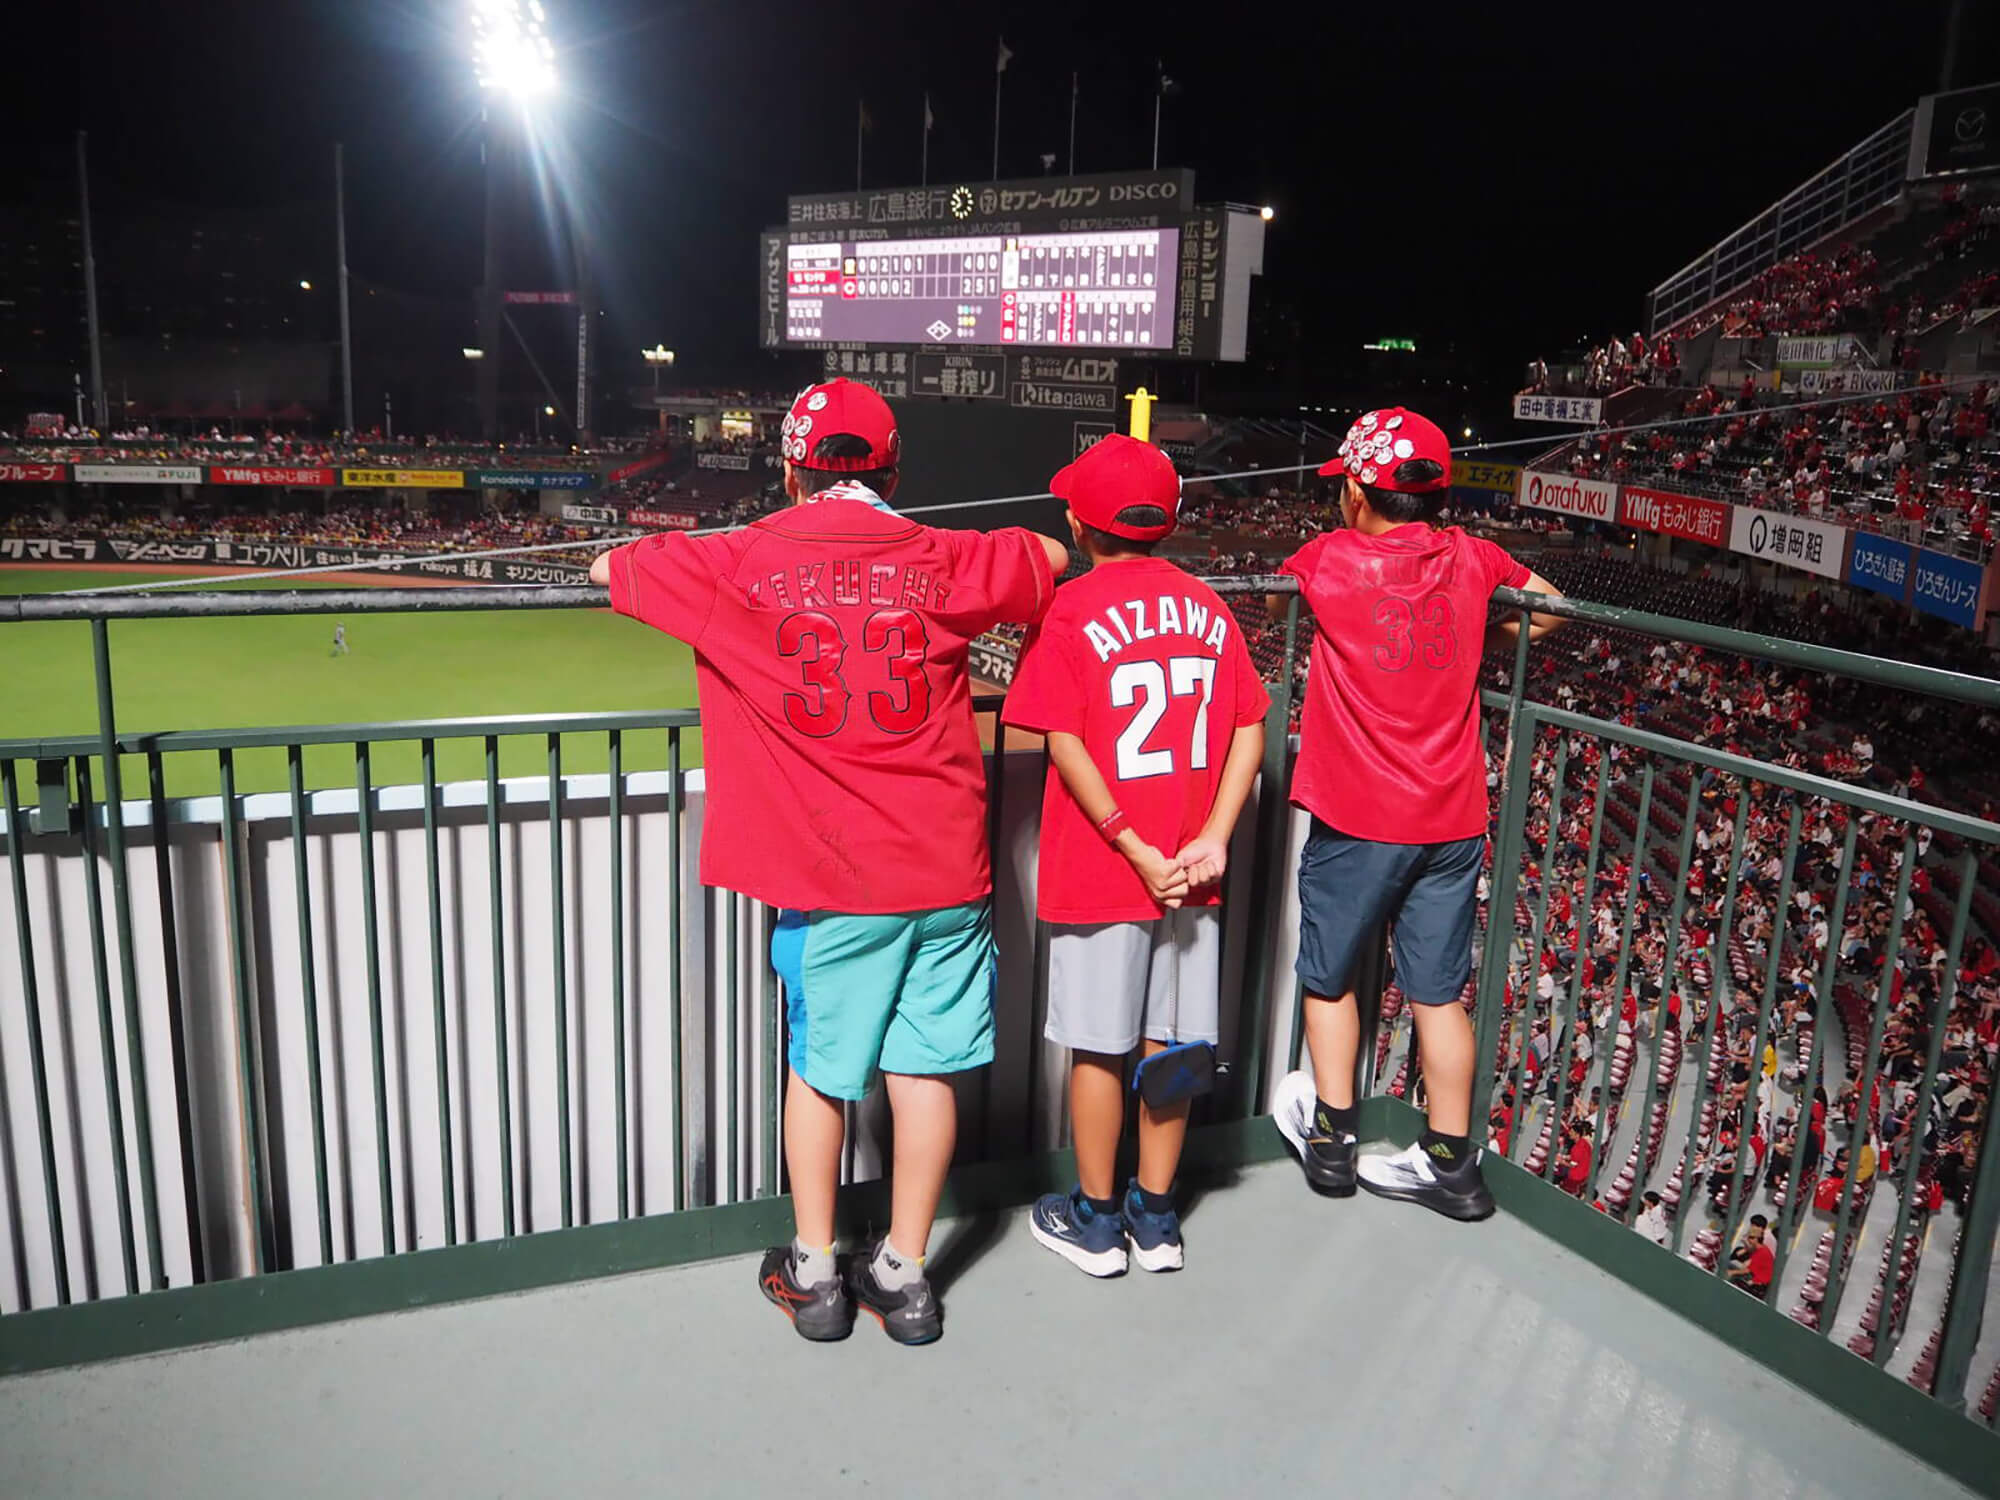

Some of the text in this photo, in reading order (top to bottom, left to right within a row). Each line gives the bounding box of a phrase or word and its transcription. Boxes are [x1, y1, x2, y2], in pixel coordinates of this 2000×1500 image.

[867, 190, 948, 223] 広島銀行
[1110, 183, 1177, 200] DISCO
[790, 202, 863, 222] 三井住友海上
[766, 238, 781, 346] アサヒビール
[1178, 220, 1199, 357] 広島市信用組合
[945, 356, 973, 367] KIRIN
[1062, 357, 1119, 383] ムロオ
[922, 368, 996, 395] 一番搾り
[1519, 398, 1595, 420] 田中電機工業
[223, 469, 321, 484] YMfg もみじ銀行
[480, 474, 535, 485] Kanadevia
[1625, 493, 1723, 541] YMfg もみじ銀行
[1, 539, 96, 560] クマヒラ
[235, 544, 311, 567] ユウベル
[1769, 523, 1824, 564] 増岡組
[463, 559, 493, 579] 福屋
[1854, 548, 1908, 585] ひろぎん証券
[1915, 566, 1977, 610] ひろぎんリース
[1082, 596, 1228, 662] AIZAWA
[1374, 592, 1458, 673] 33
[776, 607, 936, 739] 33
[1109, 656, 1217, 782] 27
